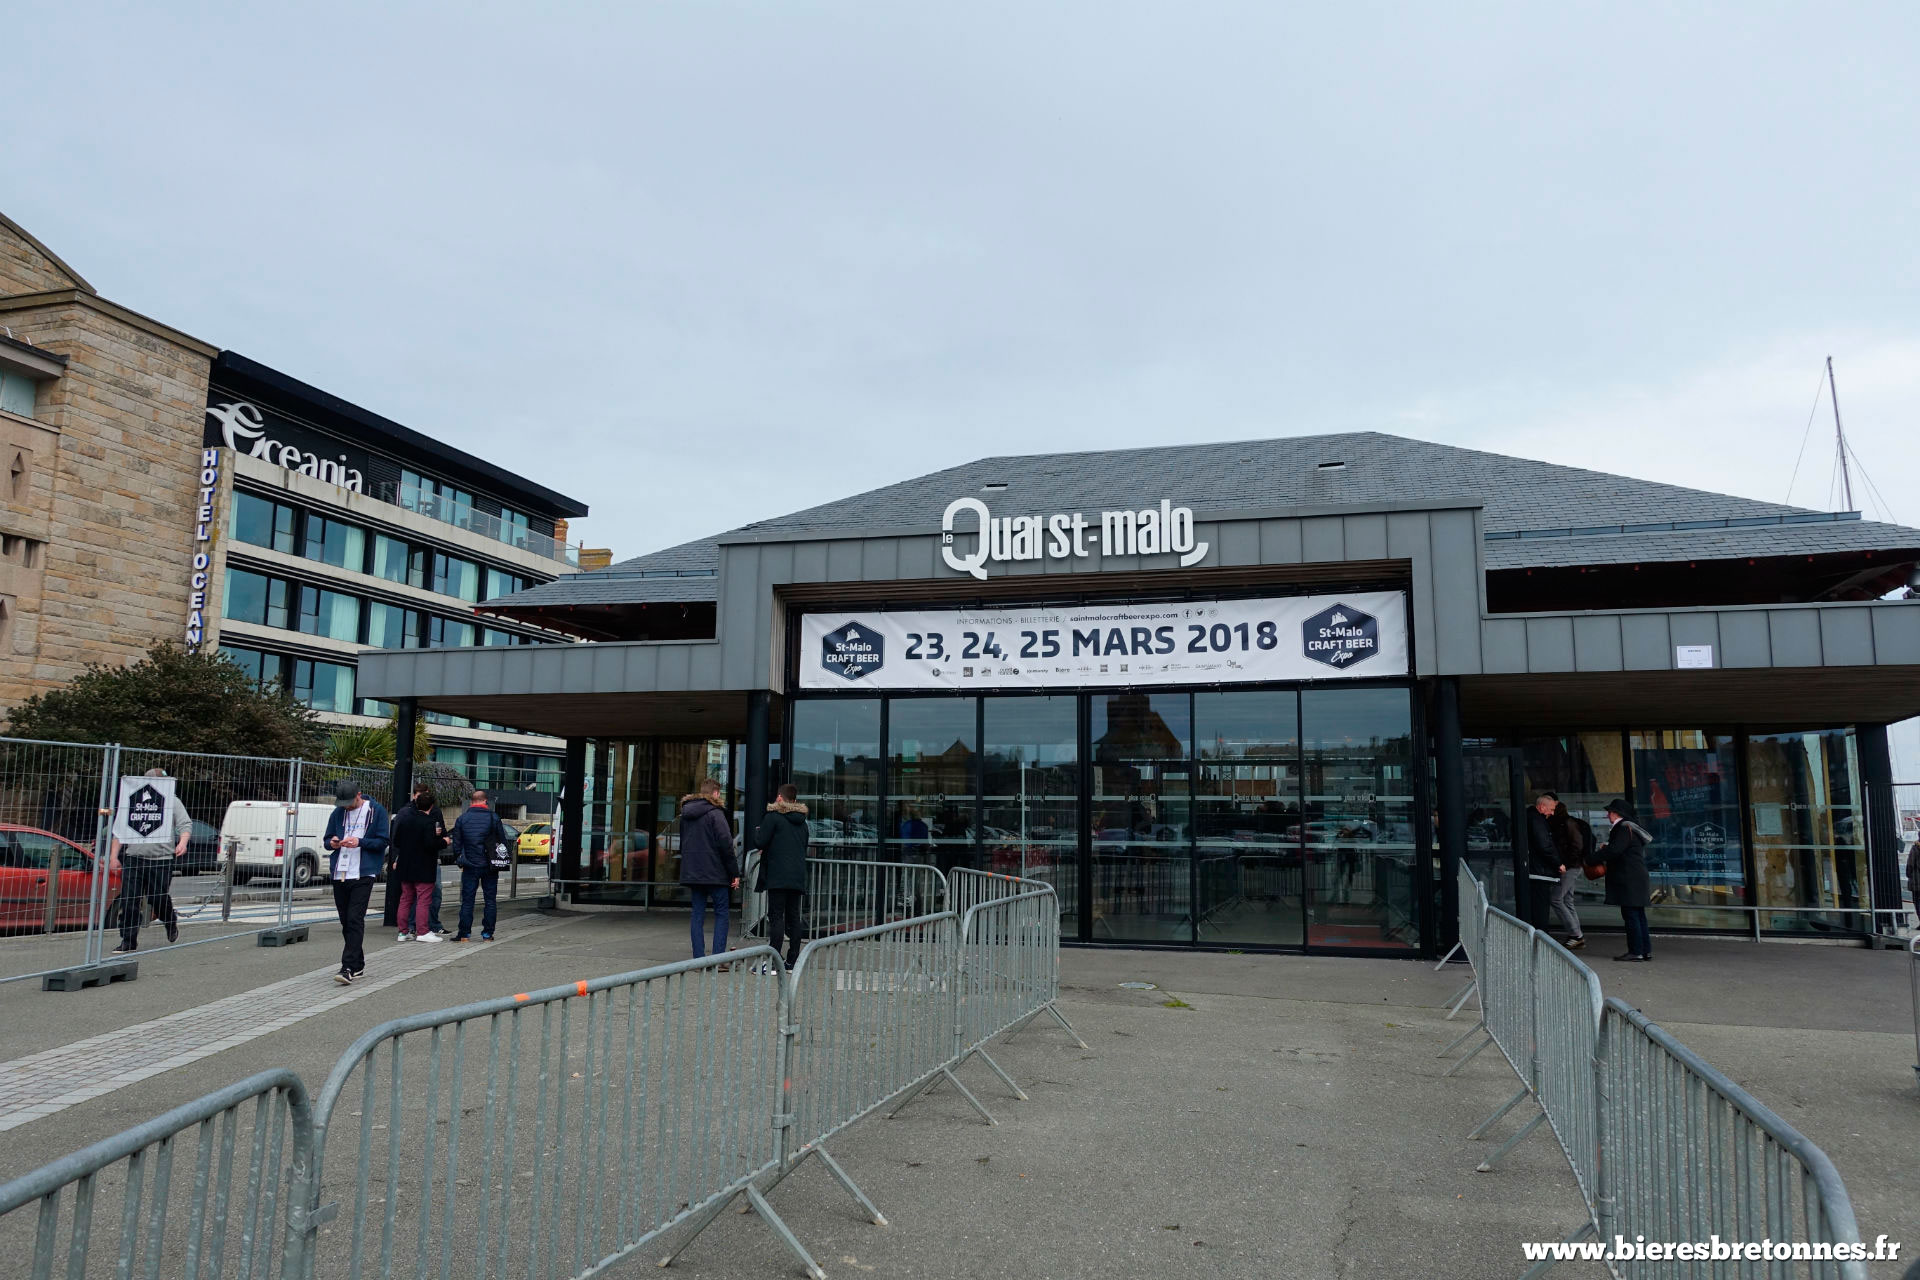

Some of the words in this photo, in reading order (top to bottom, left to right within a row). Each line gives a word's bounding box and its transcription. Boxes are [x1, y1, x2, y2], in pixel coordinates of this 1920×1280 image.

[205, 402, 363, 494] Oceania
[196, 449, 219, 541] HOTEL
[942, 531, 953, 544] le
[942, 497, 1043, 581] Quai
[186, 553, 209, 655] OCEAN
[957, 617, 1013, 625] INFORMATIONS
[1020, 615, 1060, 624] BILLETTERIE
[1069, 611, 1179, 623] saintmalocraftbeerexpo.com
[1318, 627, 1363, 638] St-Malo
[835, 642, 872, 652] St-Malo
[905, 632, 951, 663] 23,
[962, 631, 1009, 662] 24,
[1019, 629, 1061, 658] 25
[1072, 624, 1176, 657] MARS
[1187, 621, 1279, 653] 2018
[1308, 639, 1343, 651] CRAFT
[1345, 638, 1373, 649] BEER
[826, 653, 855, 663] CRAFT
[856, 653, 880, 663] BEER
[1330, 649, 1354, 663] Expo
[843, 663, 863, 675] Expo
[135, 802, 159, 811] St-Malo
[130, 813, 148, 821] CRAFT
[148, 813, 161, 821] BEER
